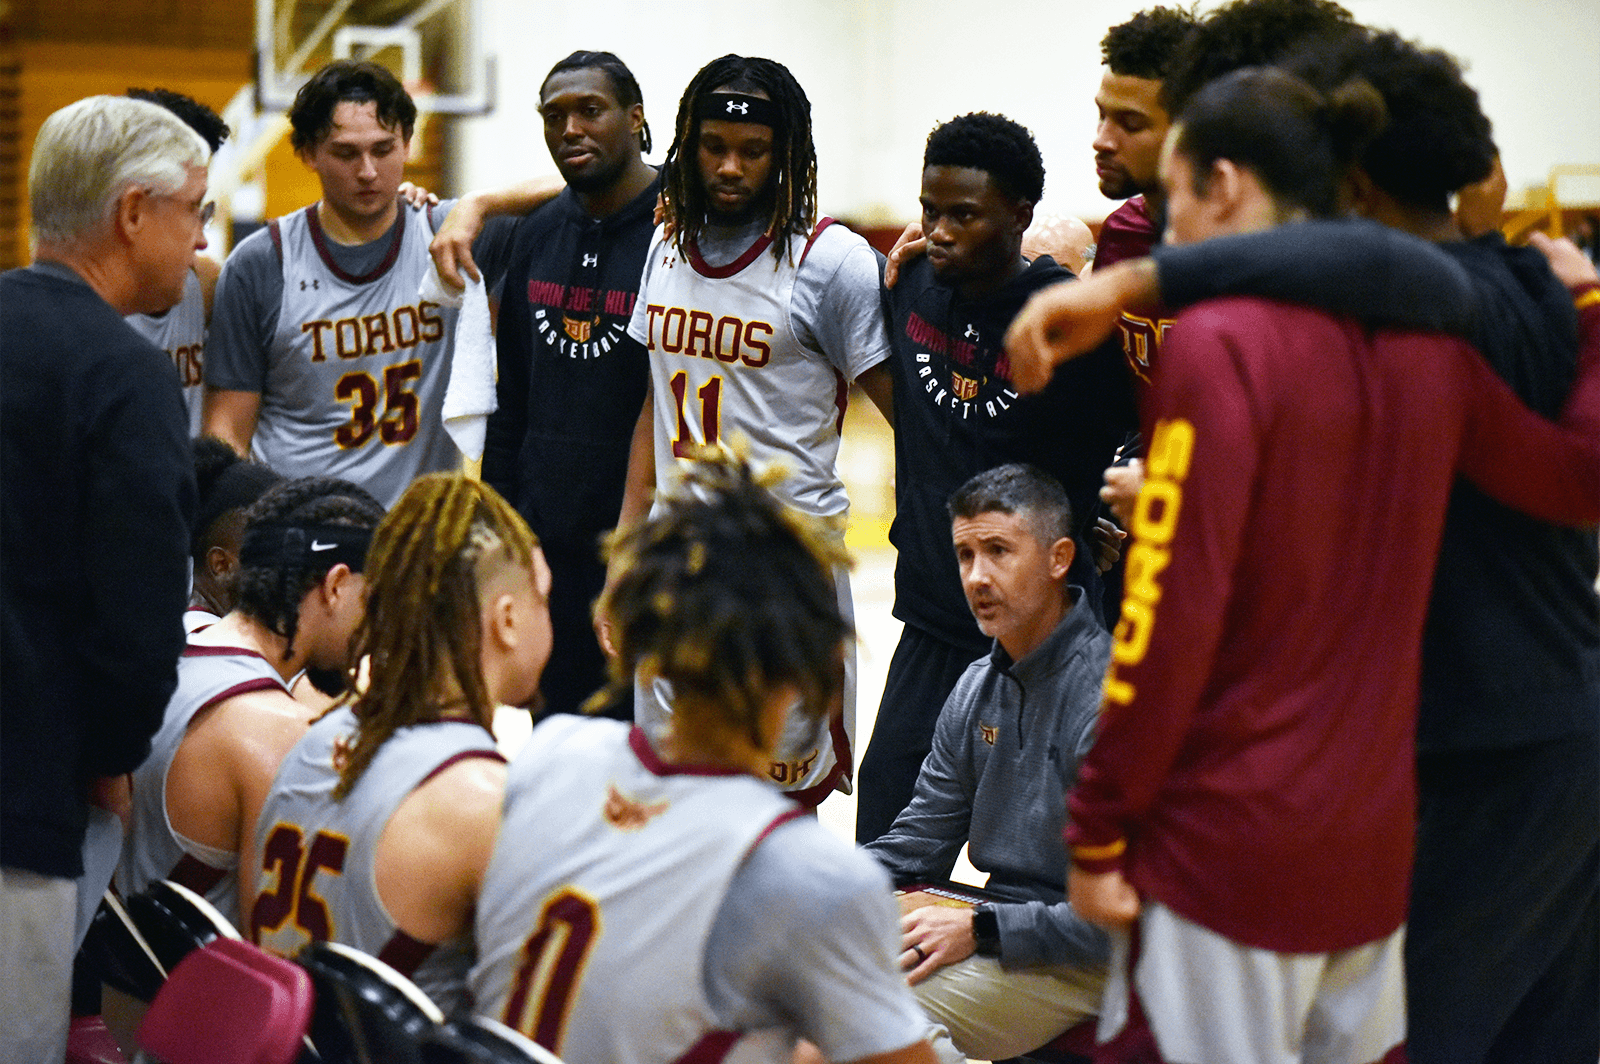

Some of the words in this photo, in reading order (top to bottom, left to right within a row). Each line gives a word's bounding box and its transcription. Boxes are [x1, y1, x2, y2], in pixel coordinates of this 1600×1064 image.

[301, 300, 444, 363] TOROS
[646, 304, 774, 368] TOROS
[334, 359, 422, 450] 35
[669, 370, 723, 460] 11
[916, 353, 1019, 419] BASKETALL
[1101, 418, 1196, 705] TOROS
[250, 821, 350, 958] 25
